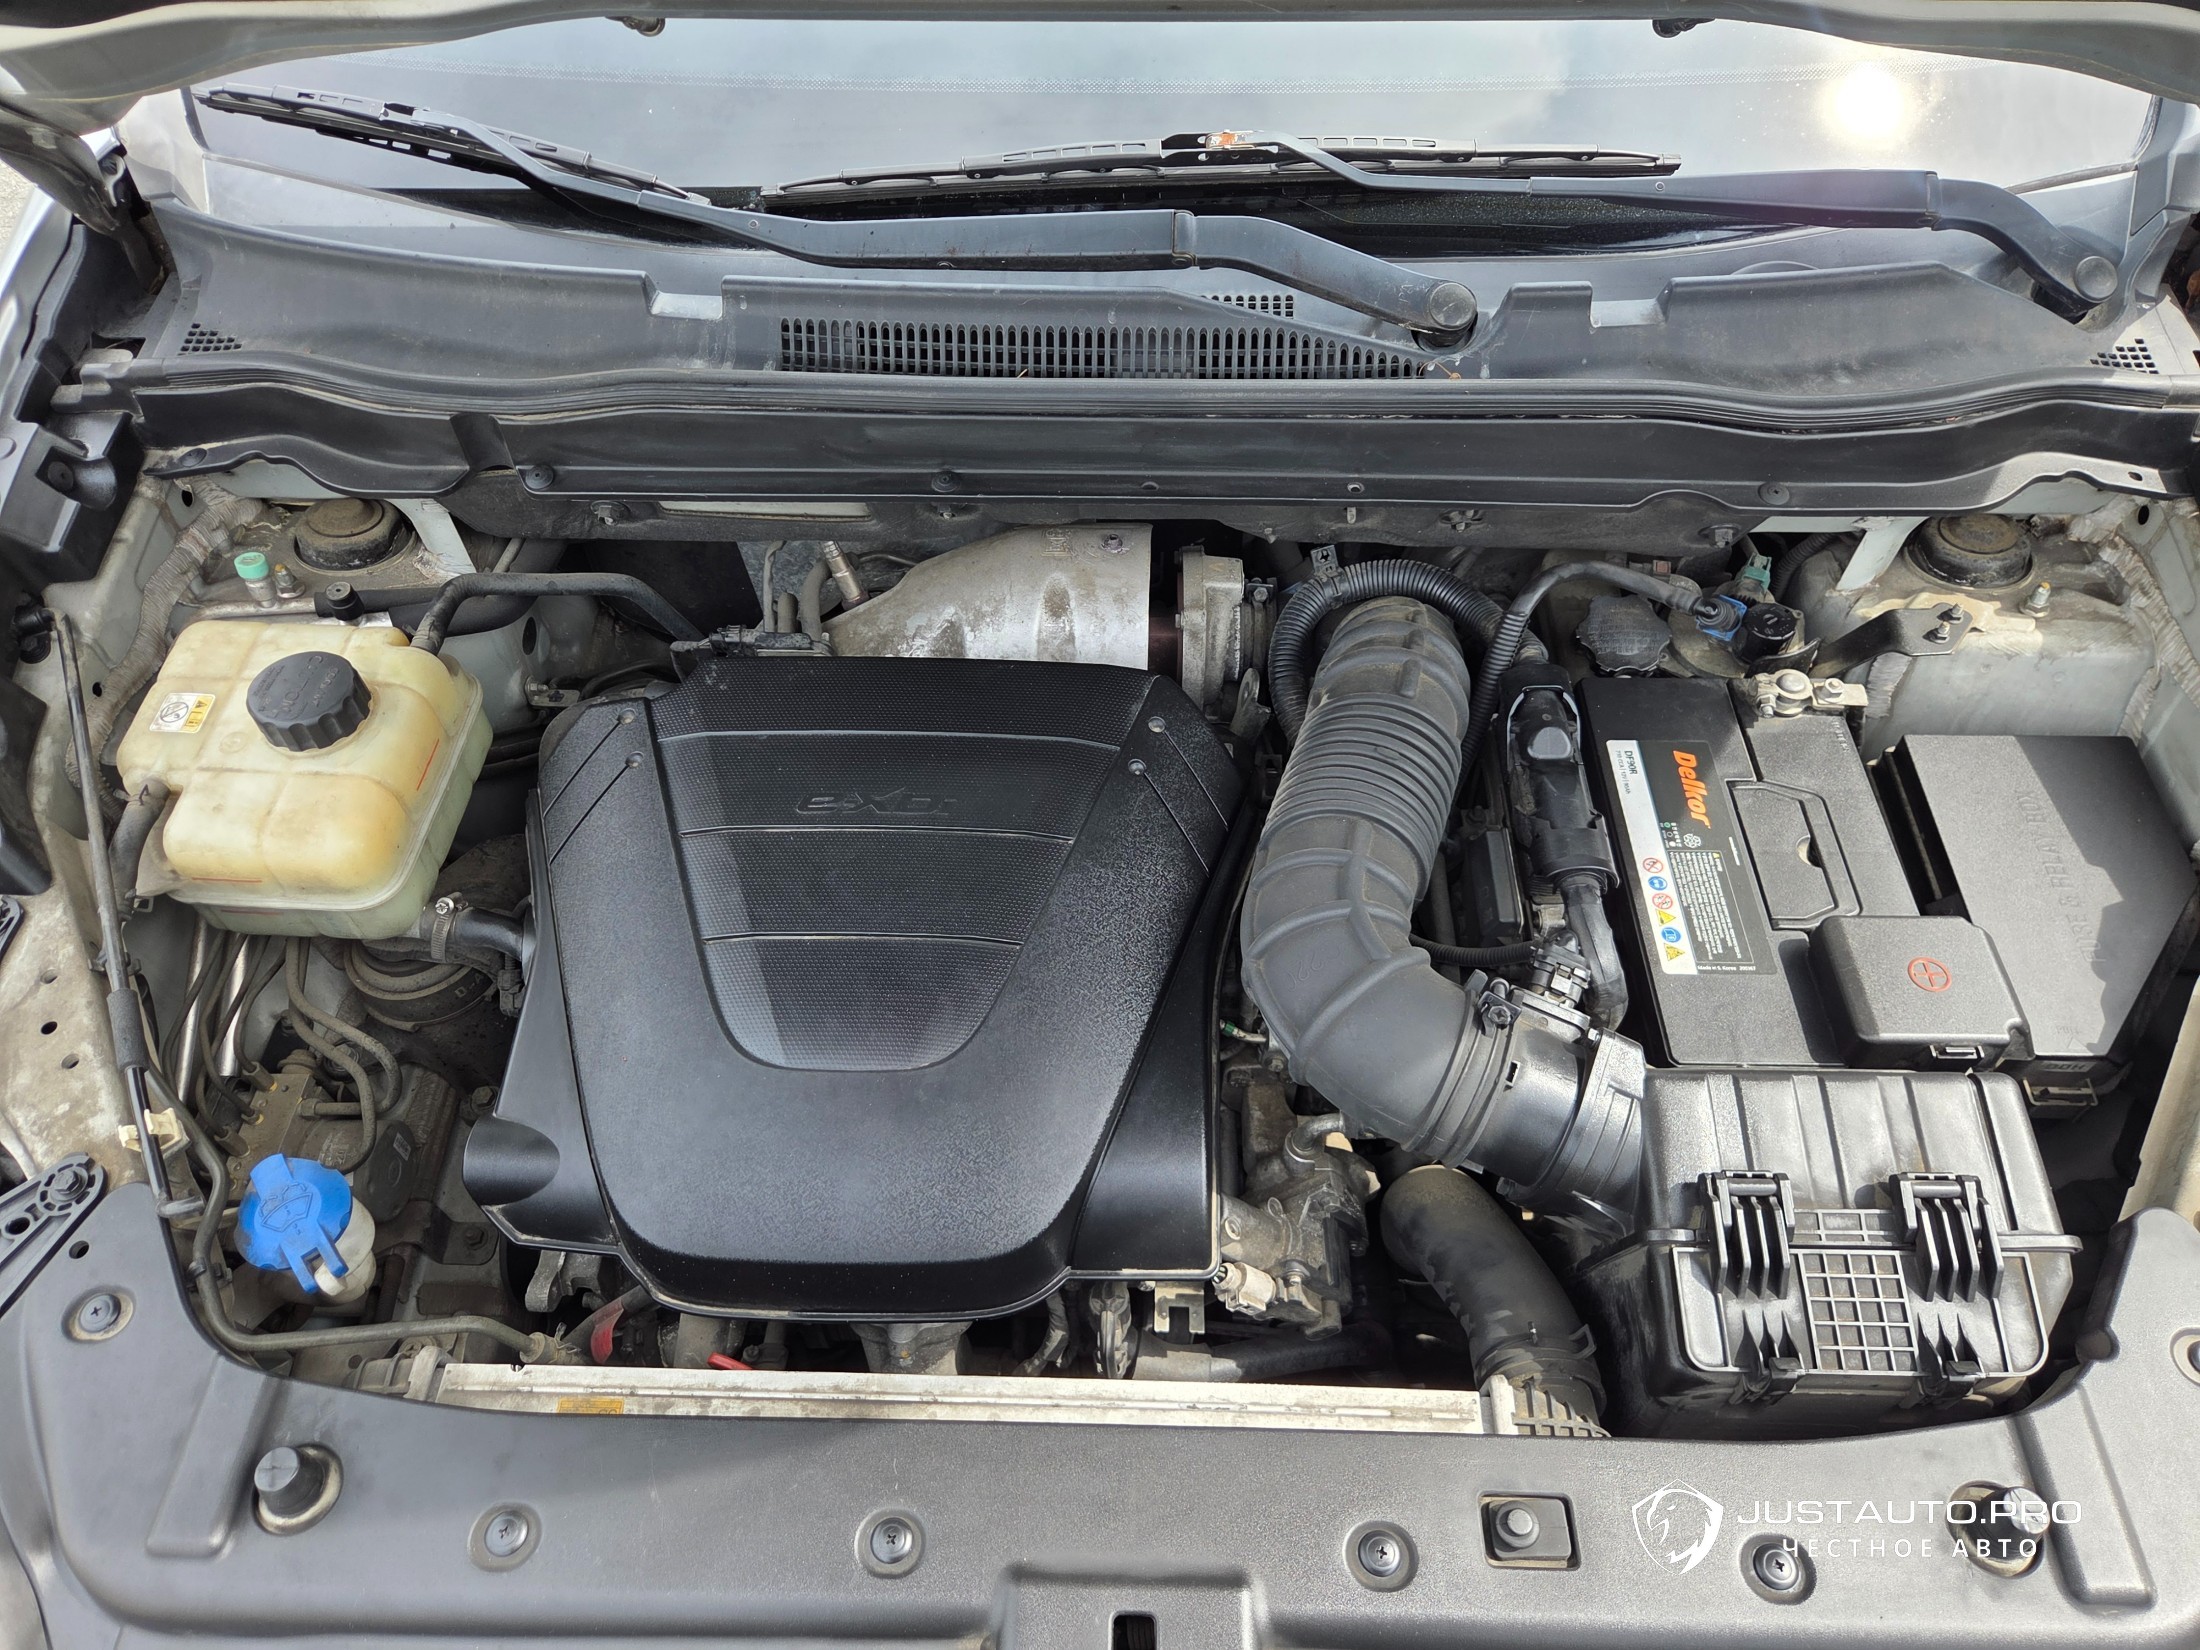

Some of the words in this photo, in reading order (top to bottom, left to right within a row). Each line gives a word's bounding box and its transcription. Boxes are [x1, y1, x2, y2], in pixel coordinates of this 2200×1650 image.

[1624, 750, 1638, 775] DF90R
[1672, 750, 1709, 828] Delkor
[2066, 912, 2107, 962] FUSE
